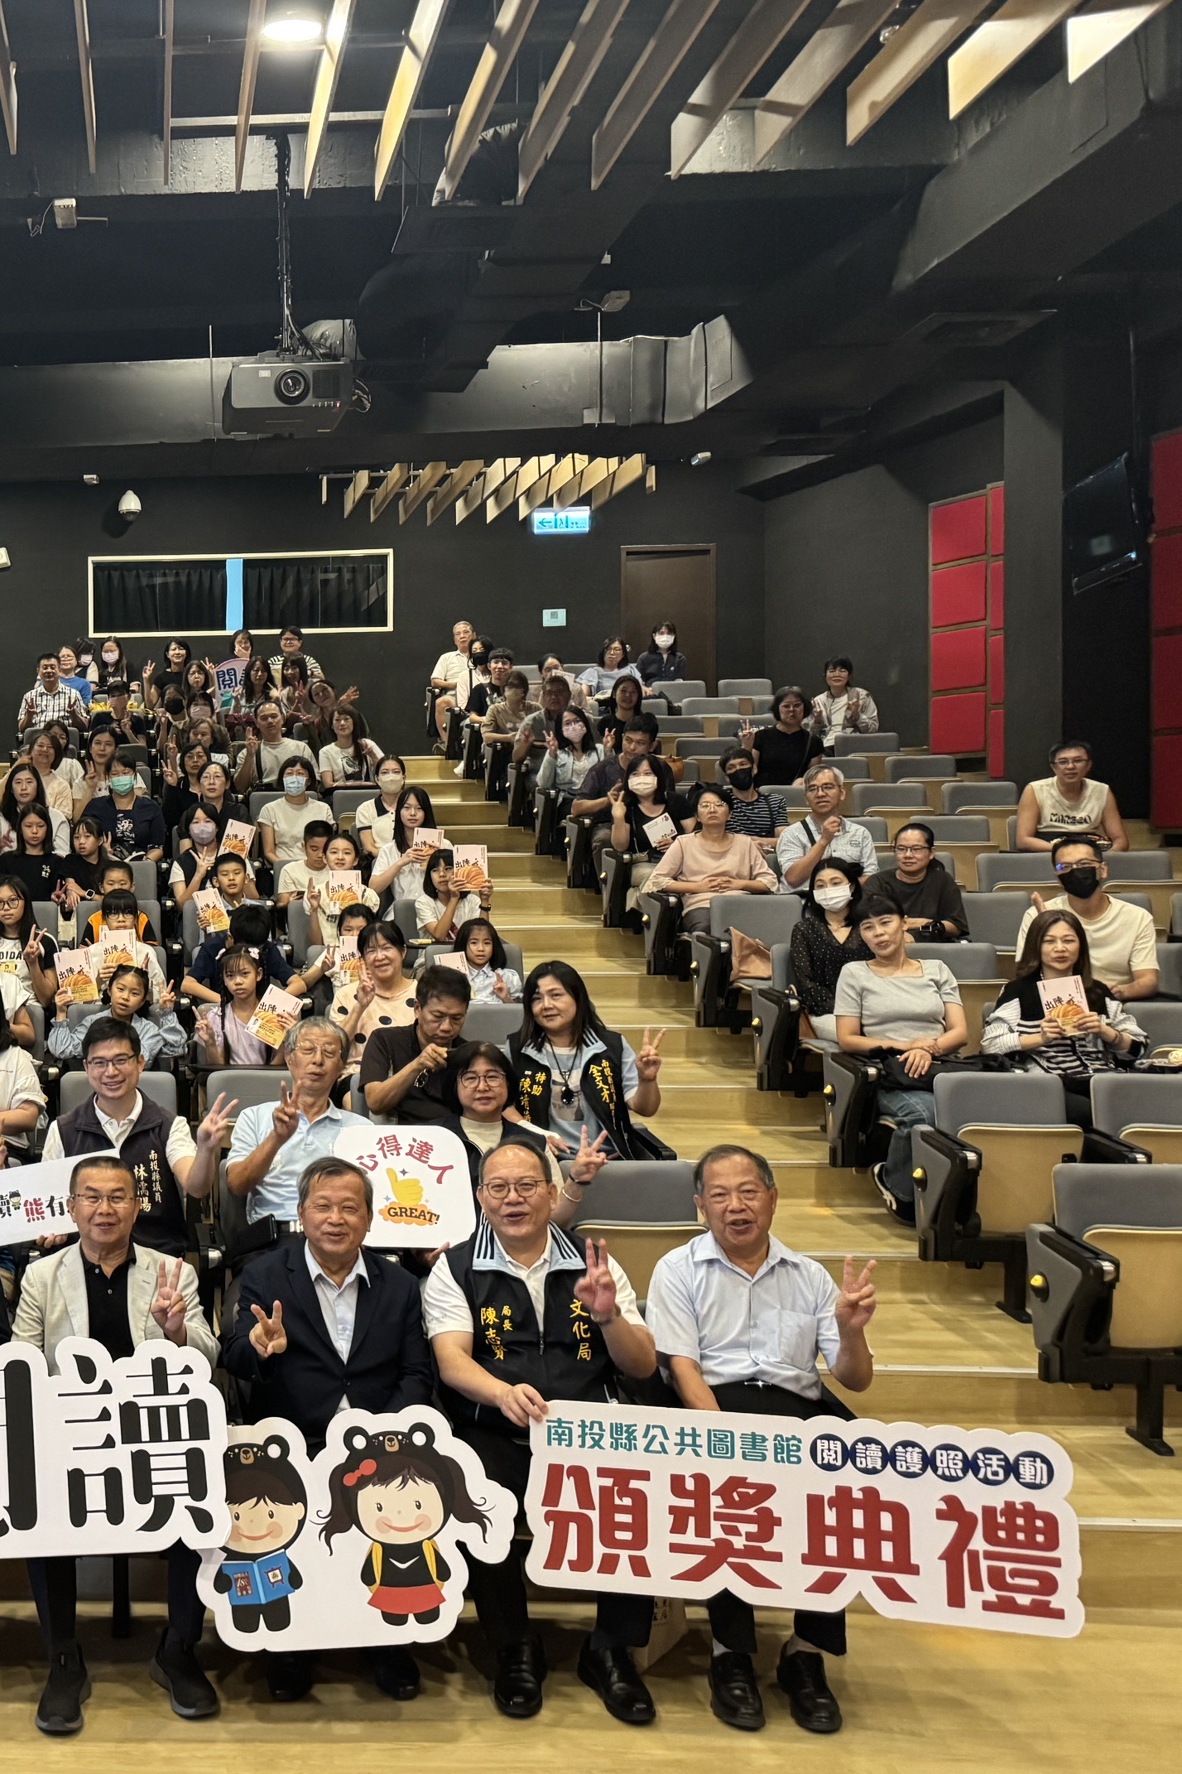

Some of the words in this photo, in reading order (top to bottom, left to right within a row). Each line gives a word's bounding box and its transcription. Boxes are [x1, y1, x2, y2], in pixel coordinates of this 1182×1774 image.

[216, 667, 246, 690] 閱
[355, 1134, 455, 1185] 心得達人
[387, 1206, 440, 1225] GREAT!
[480, 1306, 508, 1361] 陳志賢
[500, 1304, 514, 1332] 局長
[569, 1298, 592, 1362] 文化局
[544, 1417, 805, 1466] 南投縣公共圖書館
[810, 1434, 1056, 1490] 閱讀護照活動
[540, 1462, 1068, 1622] 頒獎典禮
